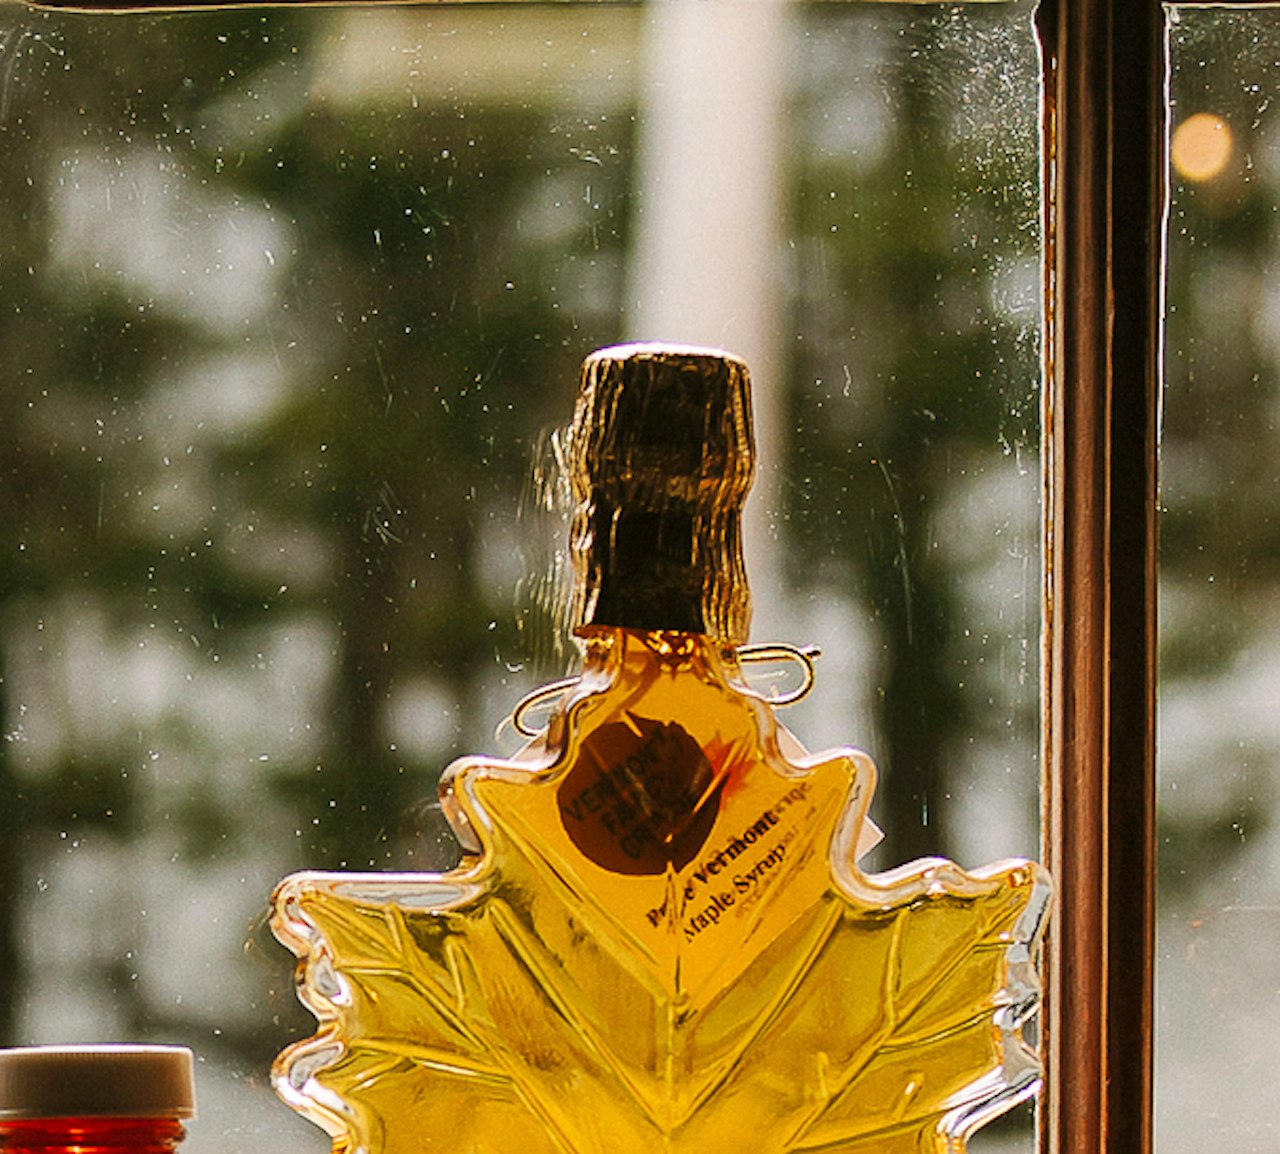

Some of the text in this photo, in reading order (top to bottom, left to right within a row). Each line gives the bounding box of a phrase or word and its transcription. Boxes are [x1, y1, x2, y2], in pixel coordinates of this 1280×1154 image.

[646, 886, 695, 928] Pe
[693, 811, 780, 884] Vermont
[683, 893, 736, 943] Maple
[733, 843, 786, 894] Syrup
